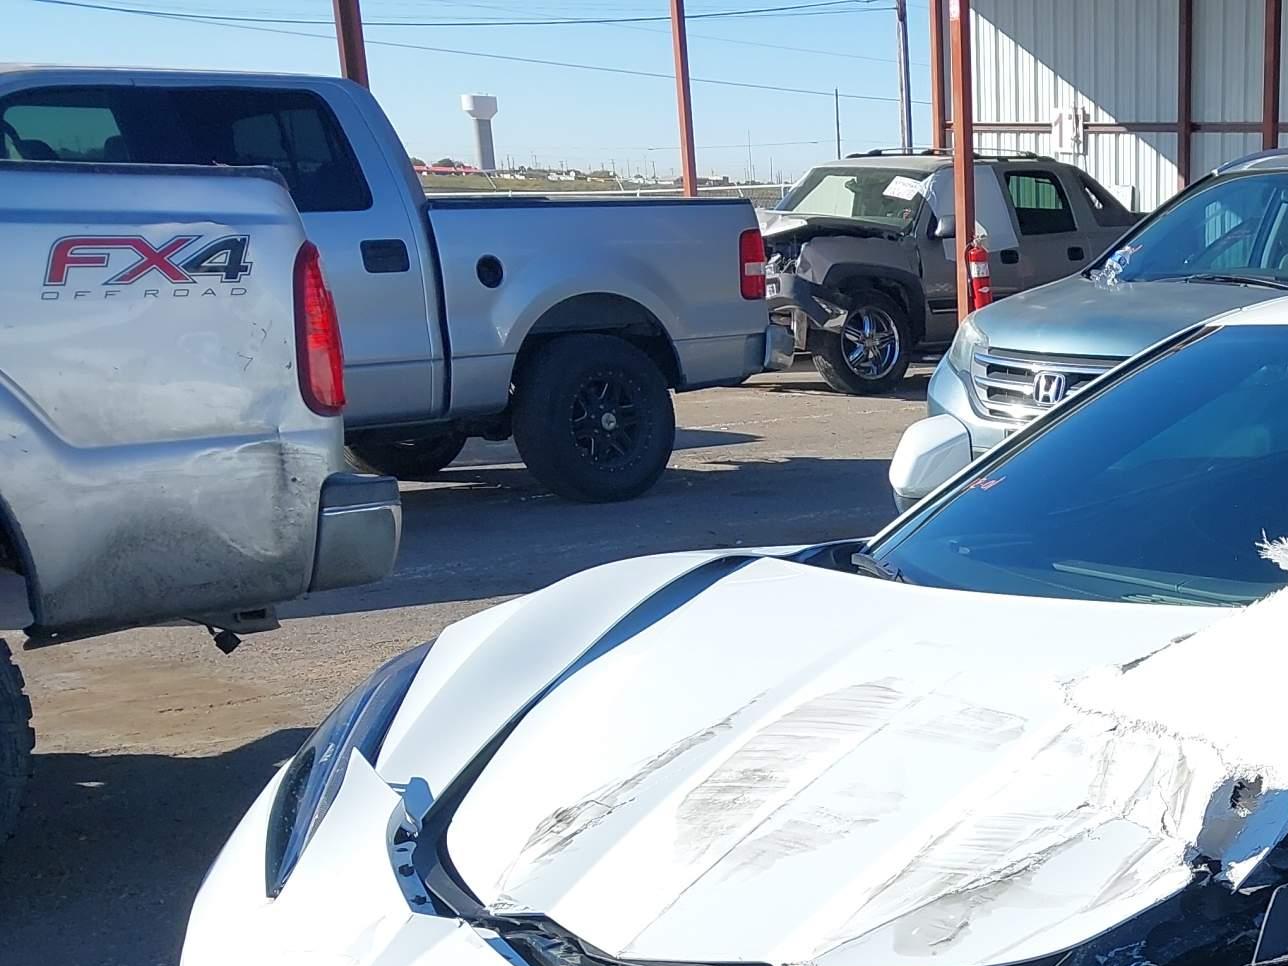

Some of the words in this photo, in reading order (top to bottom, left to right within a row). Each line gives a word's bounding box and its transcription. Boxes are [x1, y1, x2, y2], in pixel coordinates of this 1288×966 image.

[43, 235, 253, 286] FX4
[41, 290, 120, 301] OFF
[143, 286, 248, 298] ROAD
